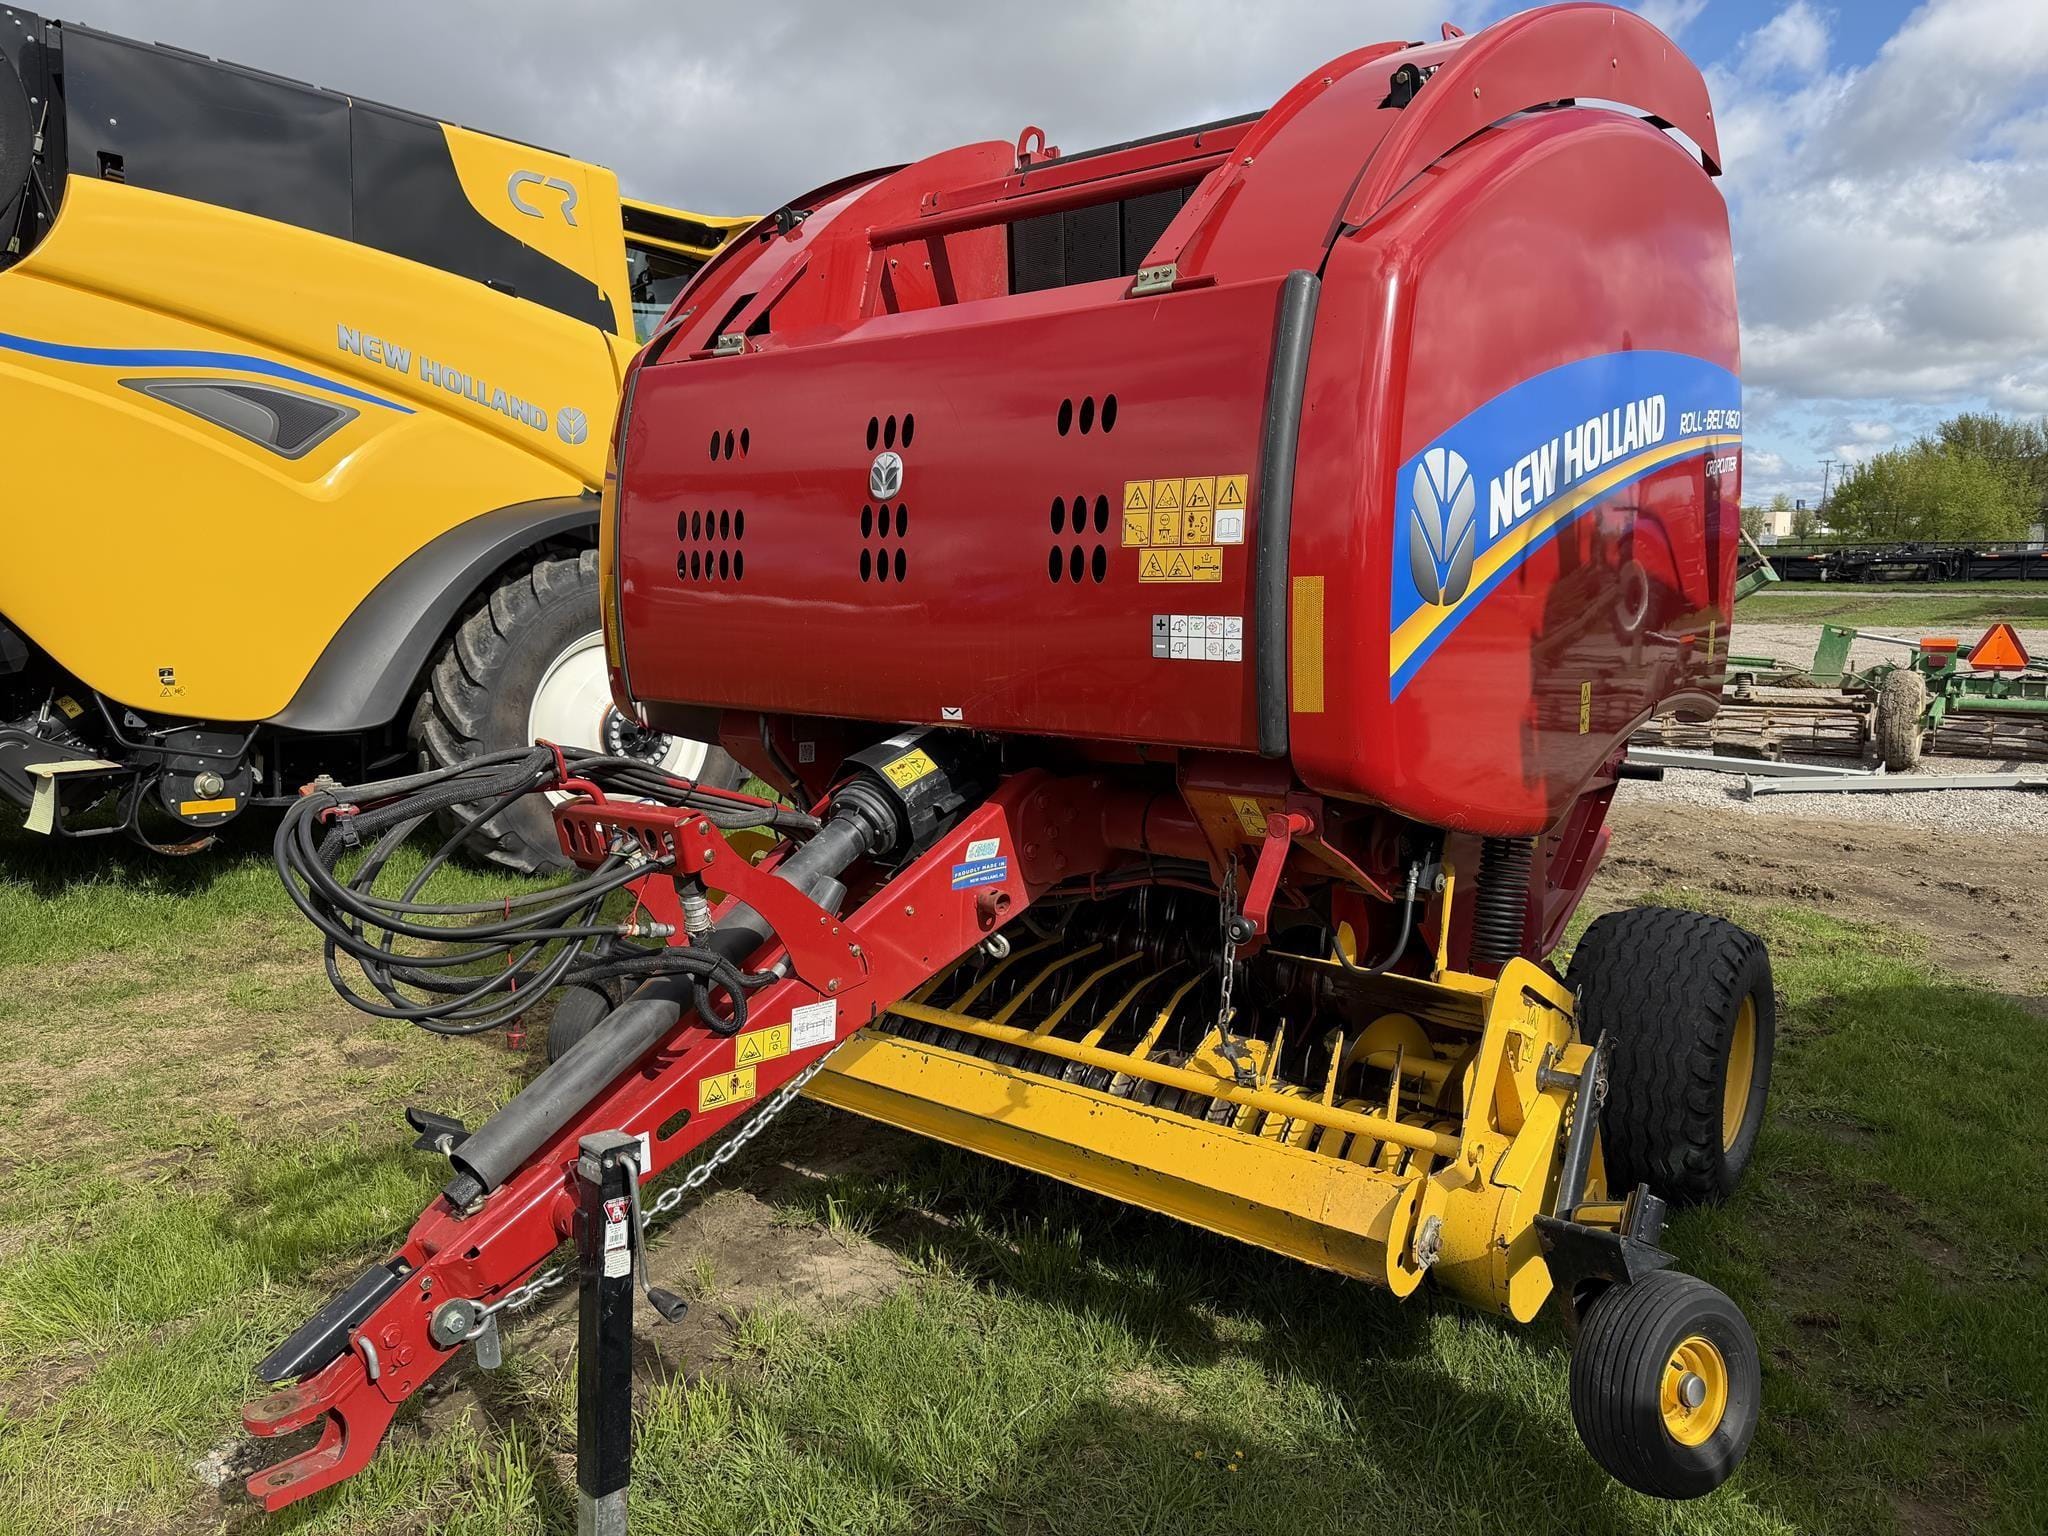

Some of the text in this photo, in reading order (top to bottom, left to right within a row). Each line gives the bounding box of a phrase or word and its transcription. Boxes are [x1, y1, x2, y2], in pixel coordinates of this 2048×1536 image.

[507, 169, 578, 228] CR
[337, 323, 549, 432] NEW HOLLAND
[1725, 409, 1740, 430] 460
[1489, 394, 1666, 540] NEW HOLLAND
[954, 867, 980, 878] PROUDLY
